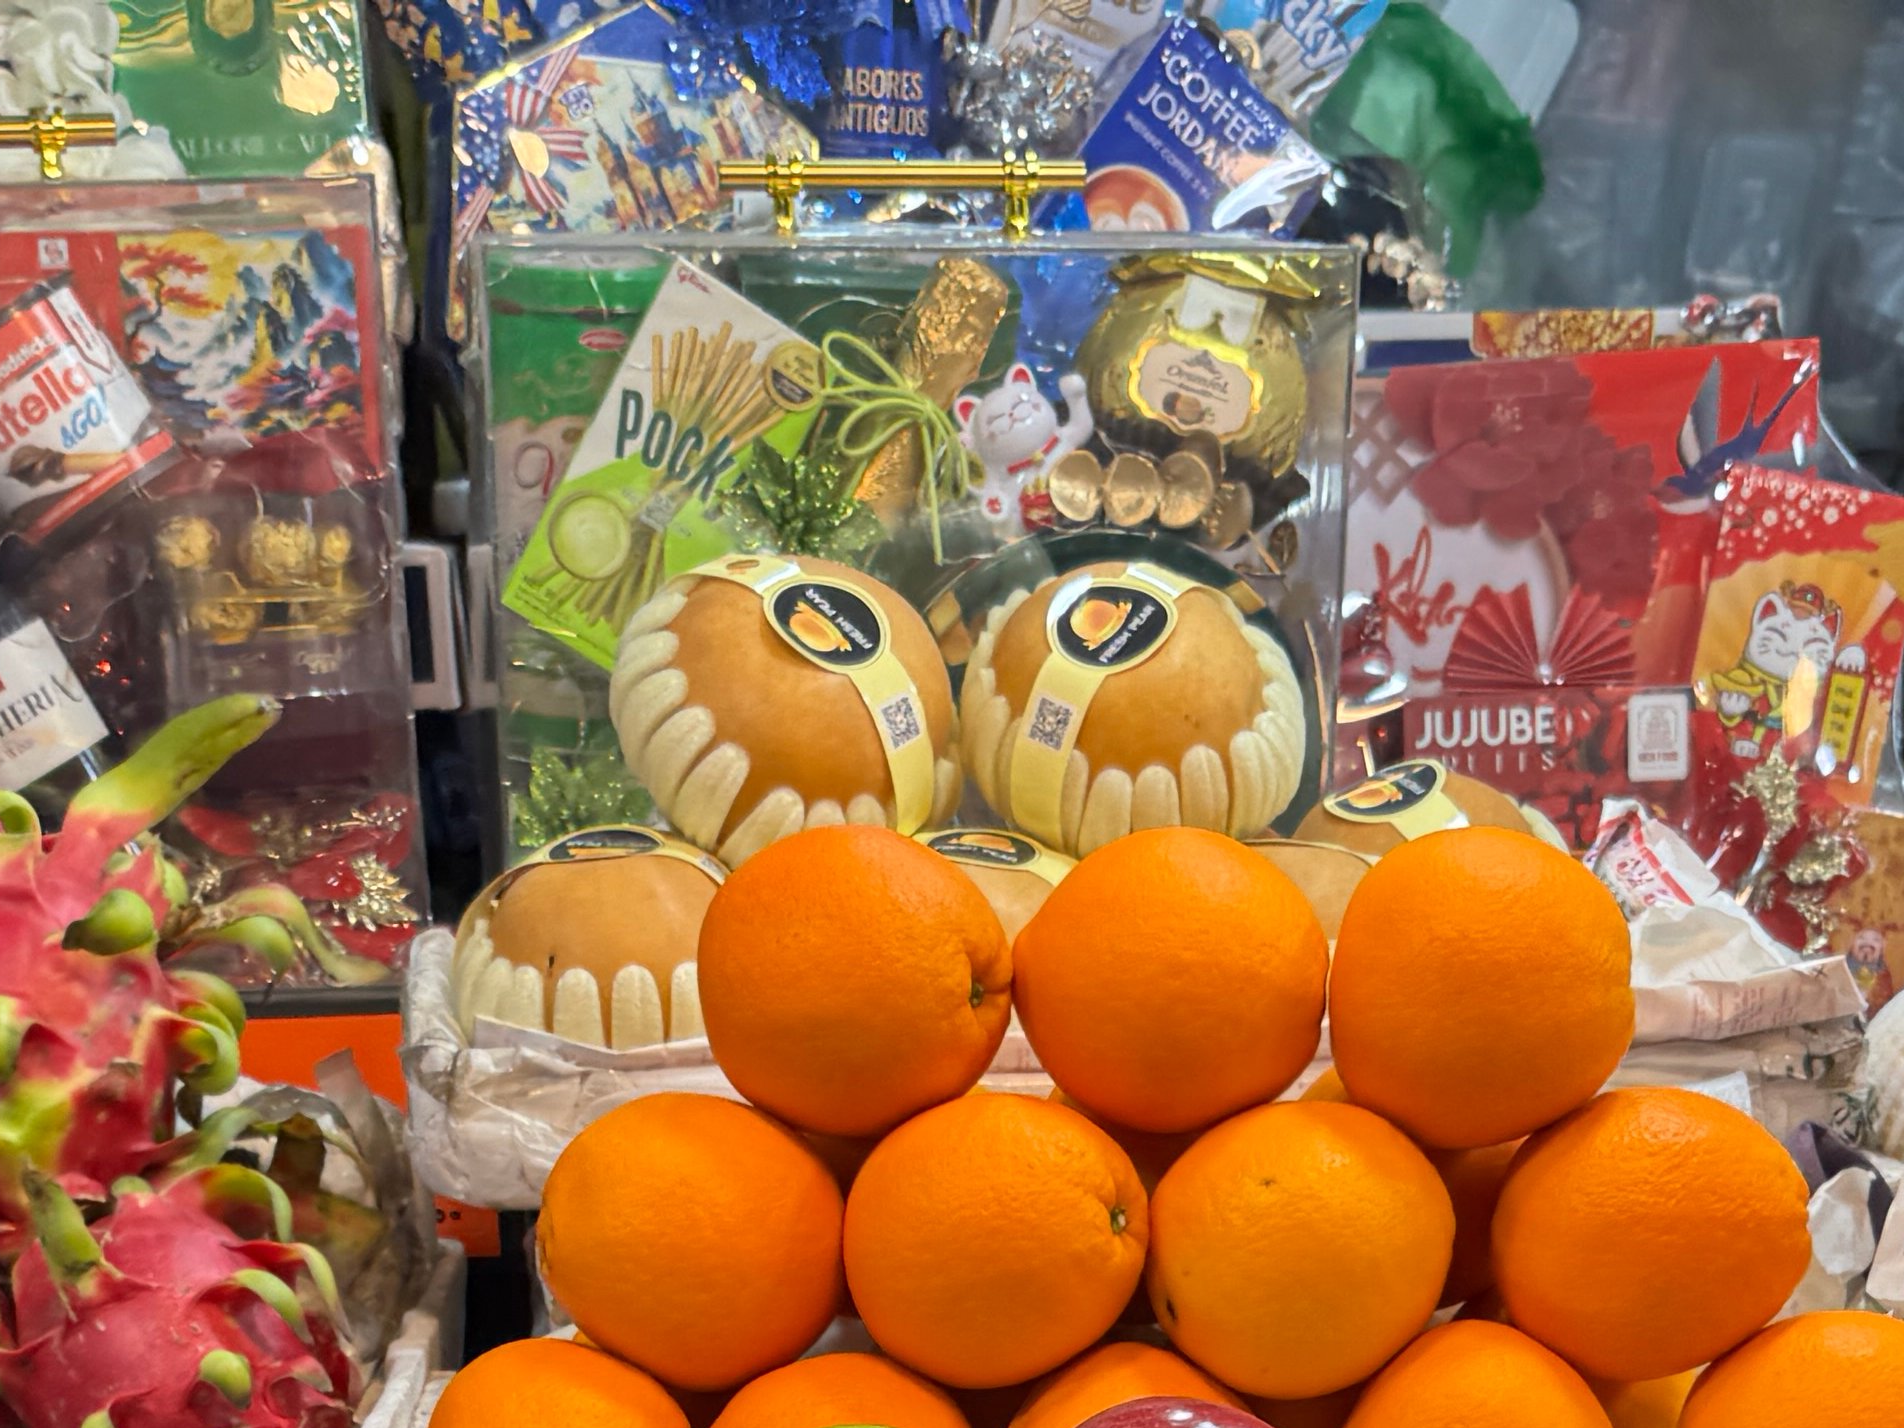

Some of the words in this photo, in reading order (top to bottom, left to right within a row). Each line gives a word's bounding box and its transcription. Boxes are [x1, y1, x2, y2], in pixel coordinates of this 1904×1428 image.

[839, 66, 924, 101] ABORES
[1164, 53, 1260, 153] COFFEE
[614, 387, 746, 503] POCK
[1415, 706, 1556, 749] JUJUBE
